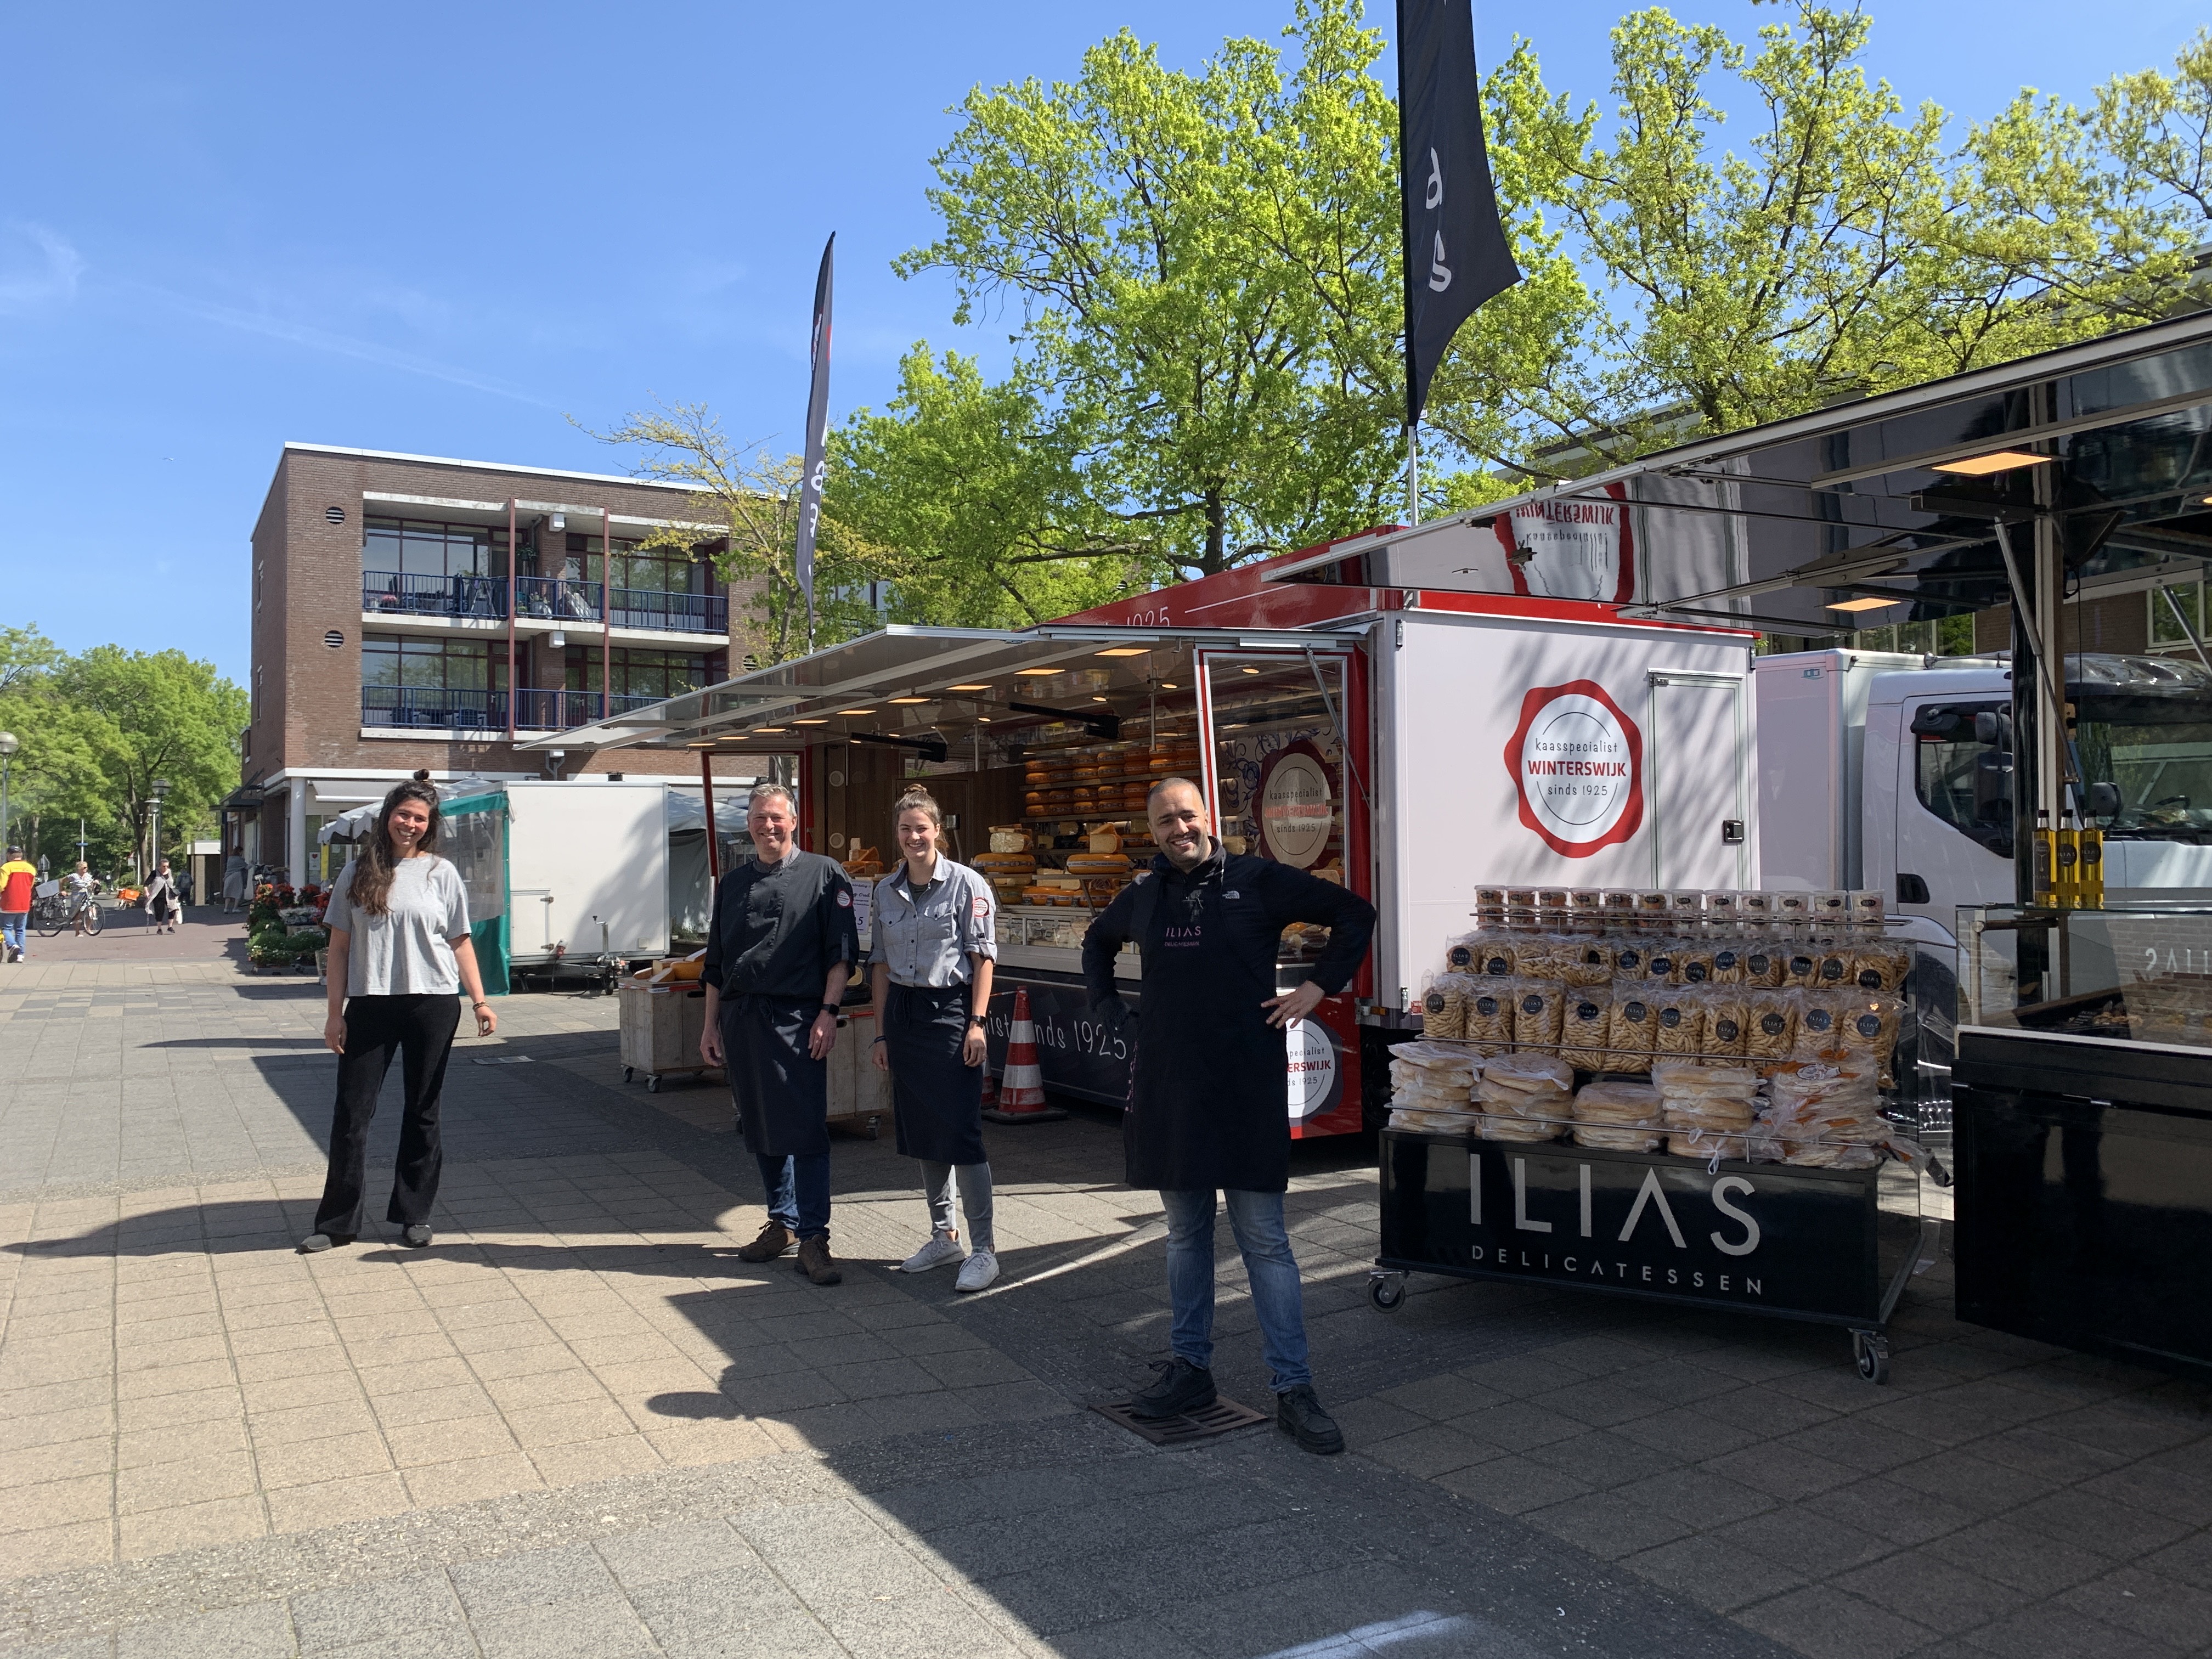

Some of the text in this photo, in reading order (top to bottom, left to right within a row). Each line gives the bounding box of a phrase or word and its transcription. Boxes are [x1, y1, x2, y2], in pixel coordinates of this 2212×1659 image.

[1536, 738, 1617, 755] kaasspecialist
[1528, 760, 1626, 777] WINTERSWIJK
[1269, 787, 1322, 802] kaasspecialist
[1548, 783, 1607, 795] sinds 1925
[1277, 823, 1316, 833] sinds 1925
[1166, 926, 1201, 937] ILIAS
[1035, 1015, 1066, 1049] nds
[1290, 1046, 1325, 1059] pecialist
[1287, 1060, 1331, 1073] ERSWIJK
[1287, 1077, 1318, 1086] ds 1925
[1470, 1154, 1760, 1256] ILIAS
[1472, 1245, 1762, 1295] DELICATESSEN
